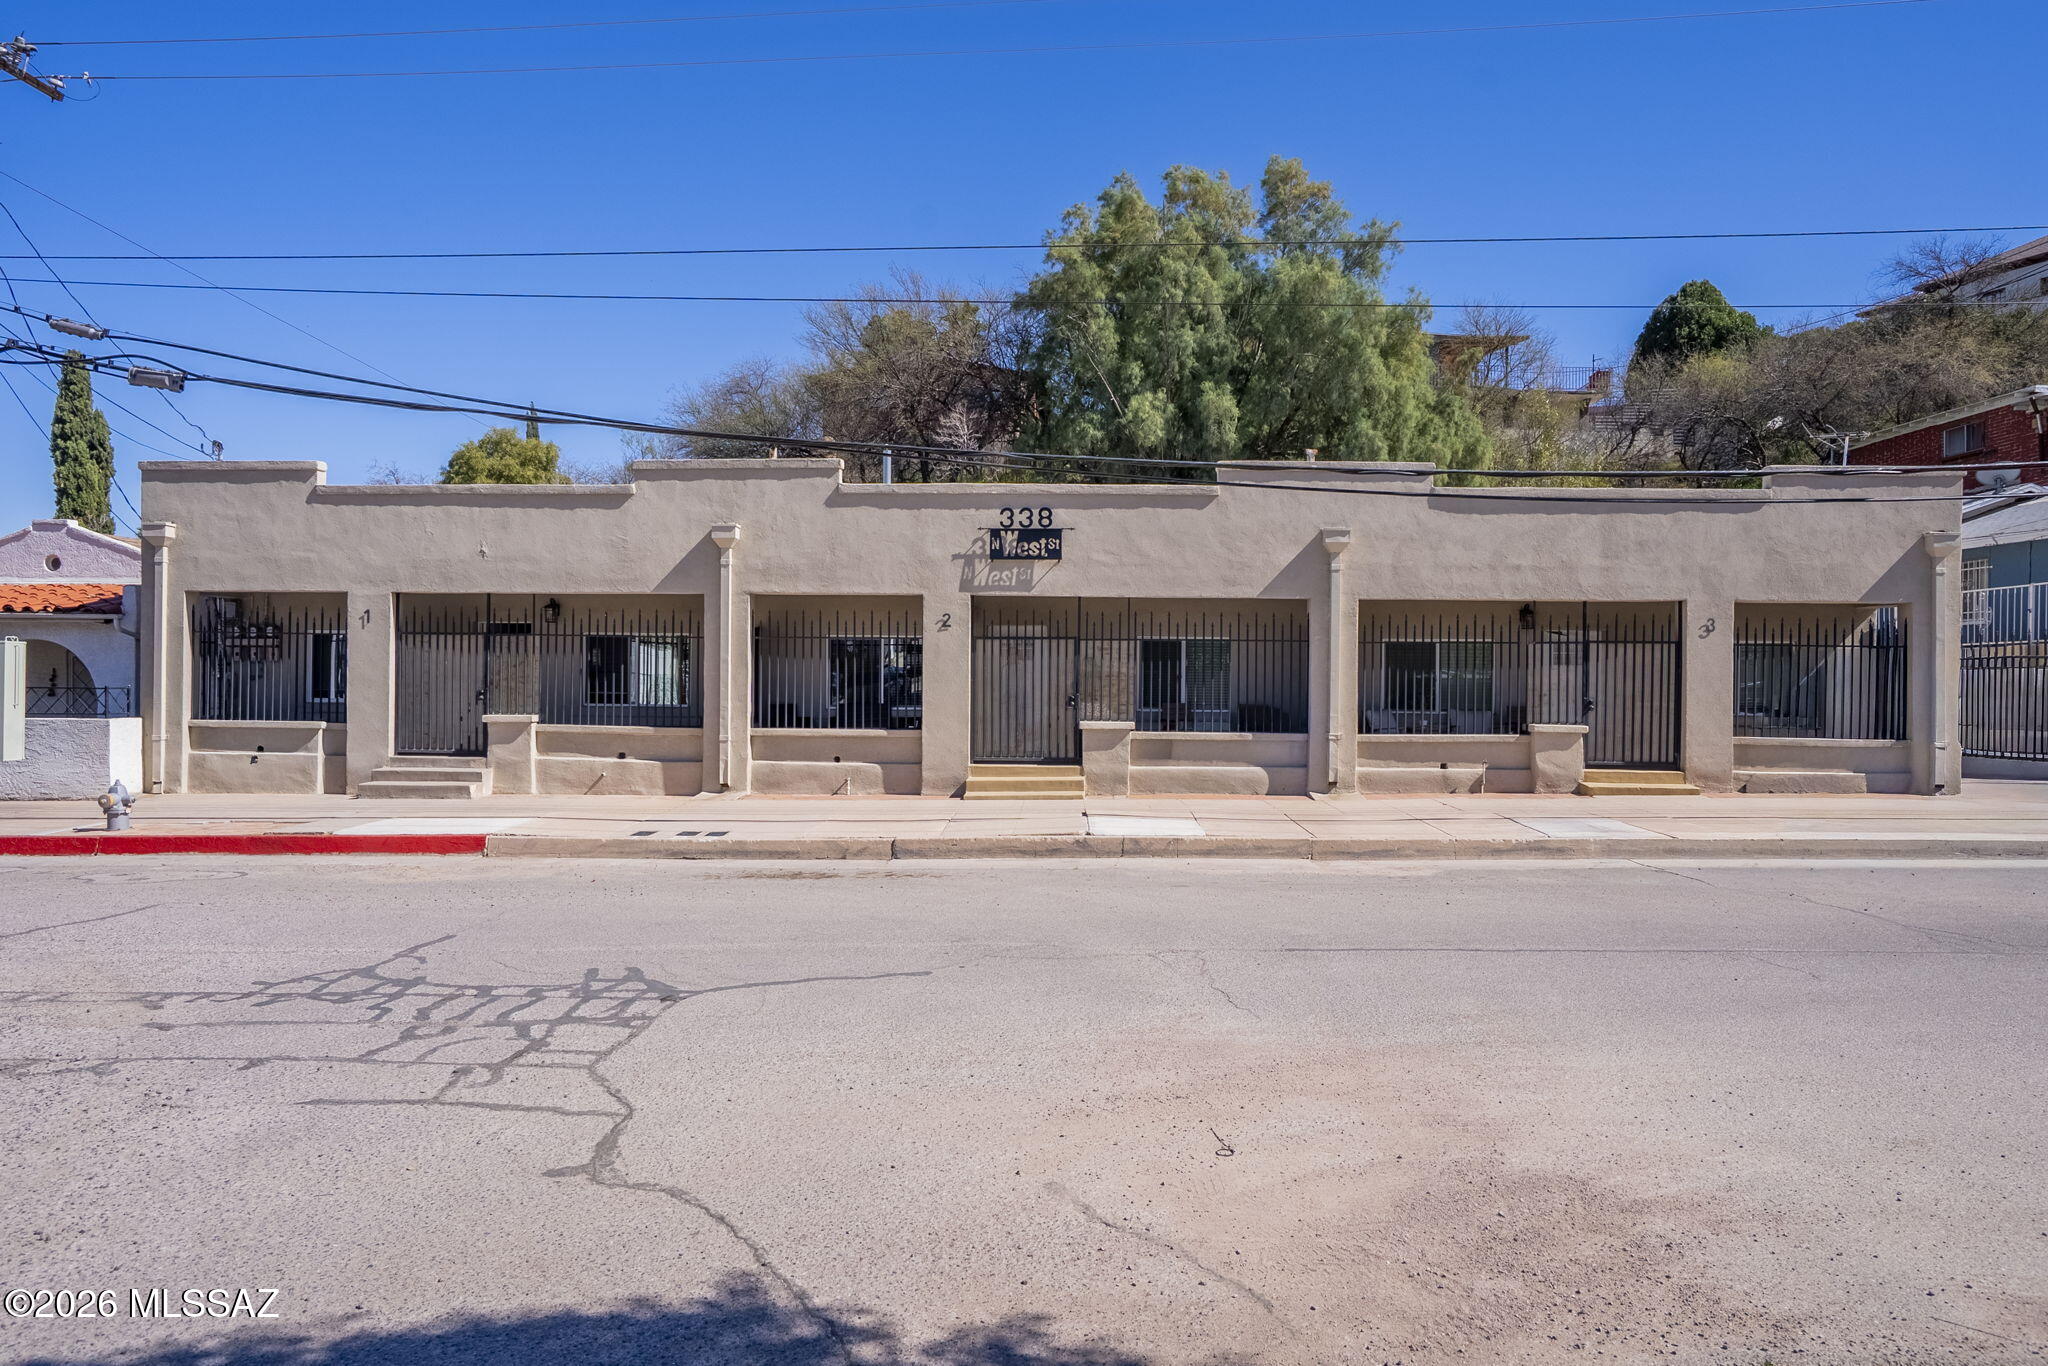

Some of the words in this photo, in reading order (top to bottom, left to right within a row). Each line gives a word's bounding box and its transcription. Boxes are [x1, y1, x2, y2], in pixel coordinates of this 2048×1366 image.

[1000, 507, 1053, 528] 338
[991, 537, 1000, 550] N
[1000, 530, 1048, 557] West
[1048, 537, 1060, 550] St
[363, 609, 370, 624] 1
[942, 613, 951, 628] 2
[1706, 618, 1715, 633] 3
